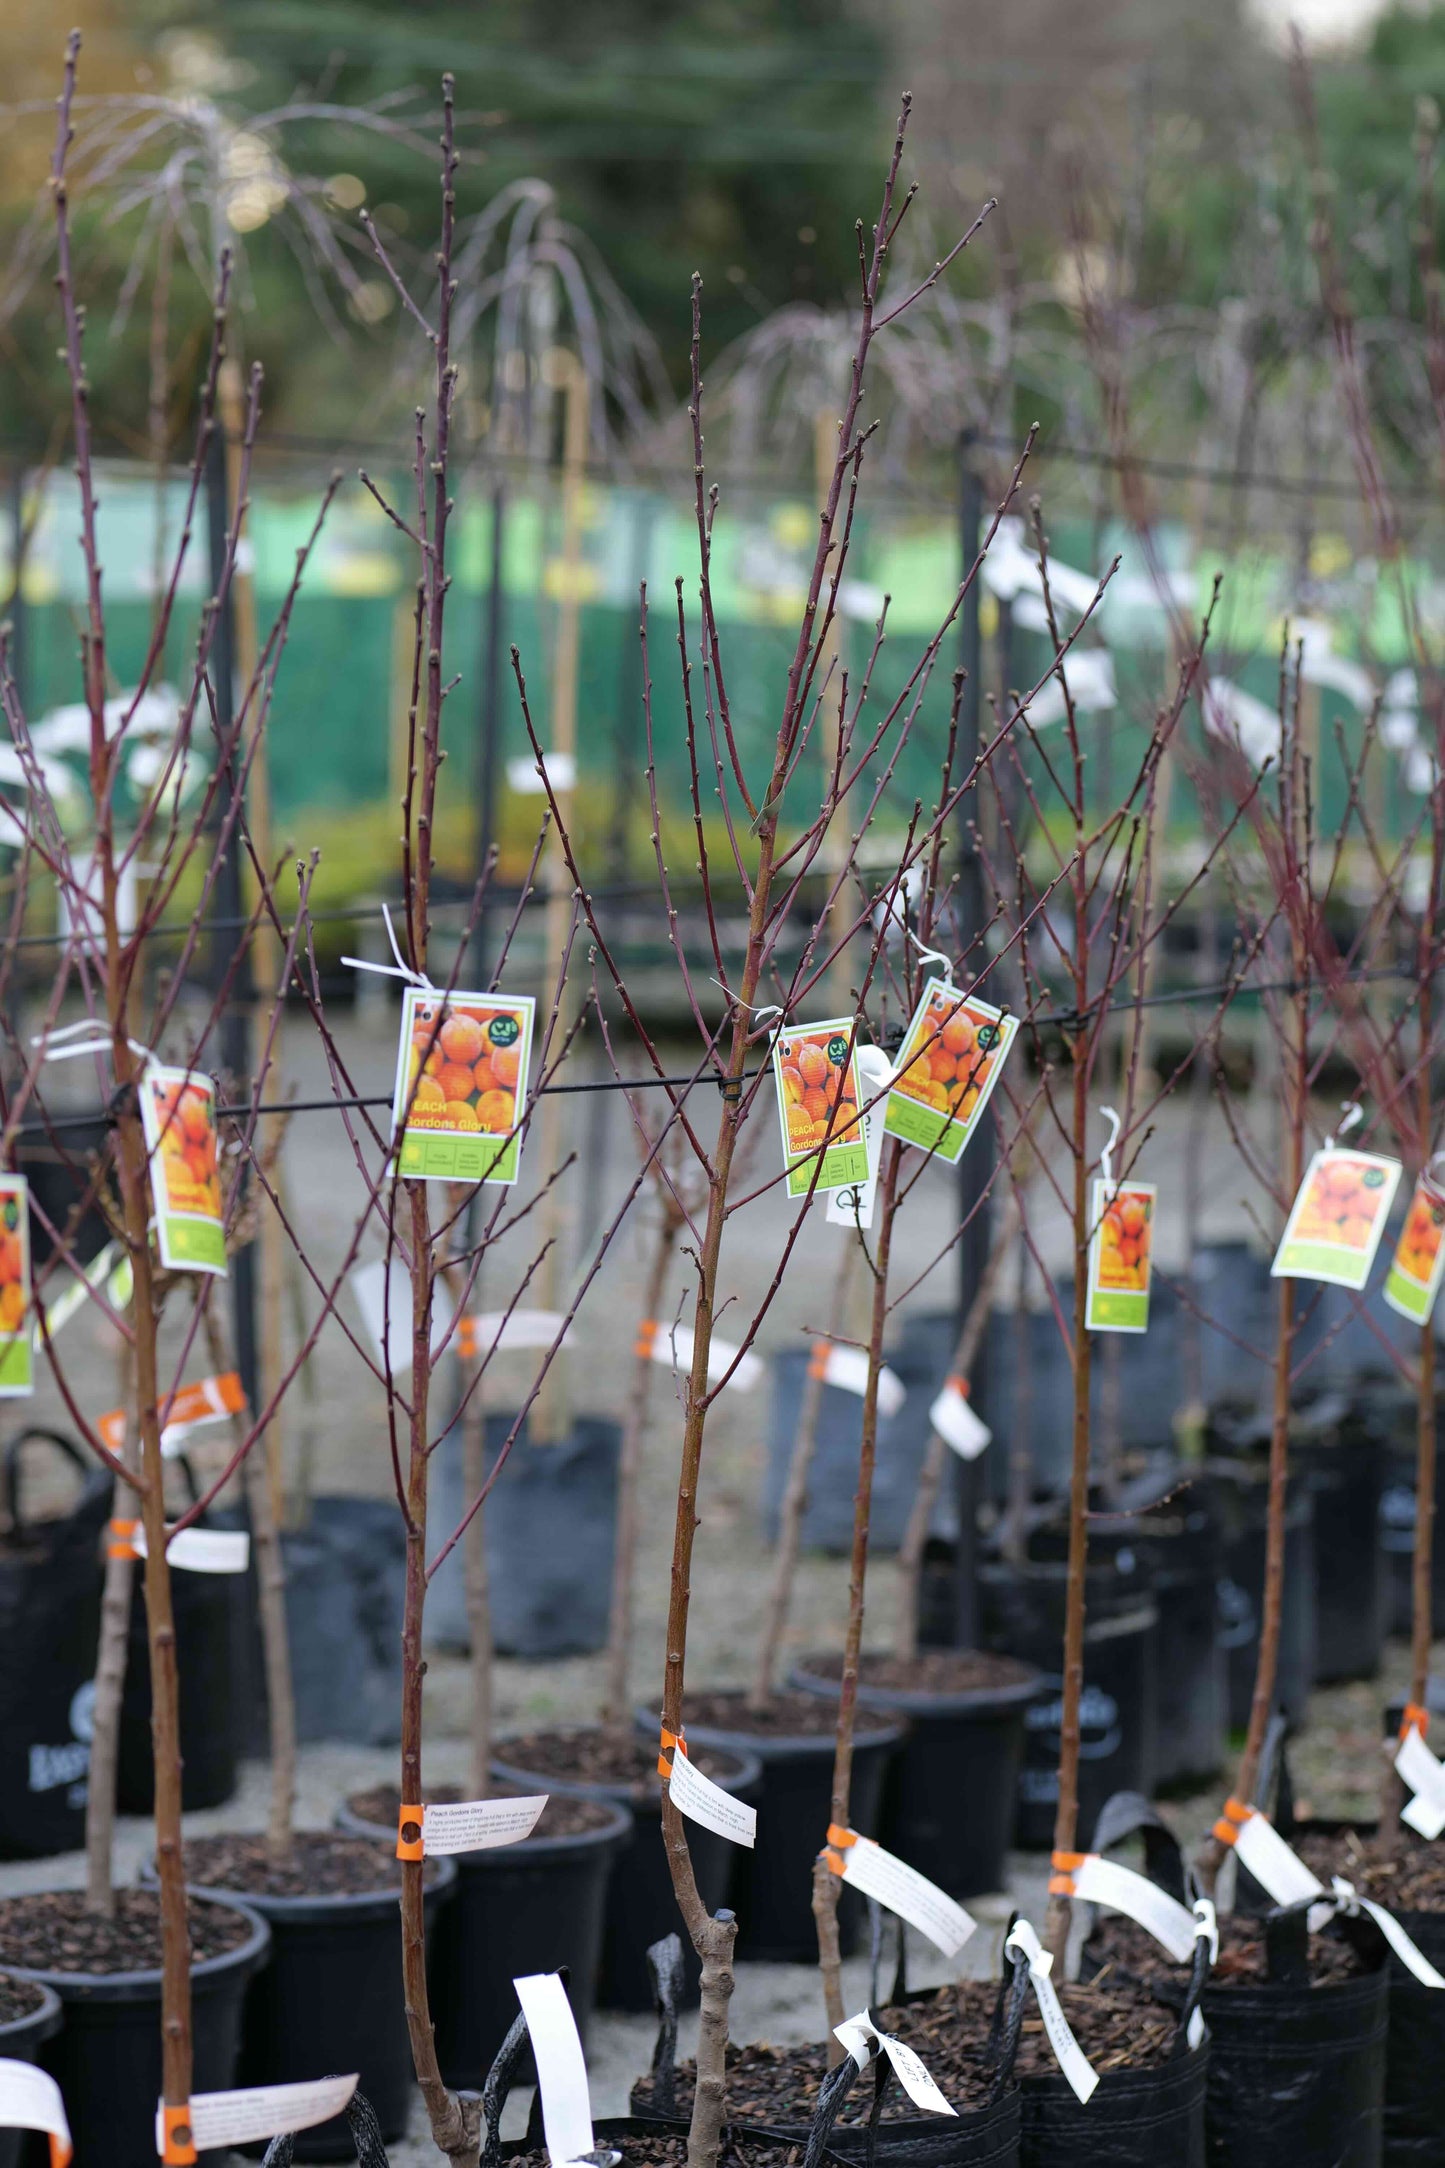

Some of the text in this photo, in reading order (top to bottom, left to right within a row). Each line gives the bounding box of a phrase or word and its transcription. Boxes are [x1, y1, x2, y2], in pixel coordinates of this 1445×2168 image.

[411, 1100, 448, 1113] EACH
[458, 1119, 492, 1134] Glory
[789, 1124, 815, 1137] PEACH
[430, 1807, 484, 1817] Peach Gordons Glory
